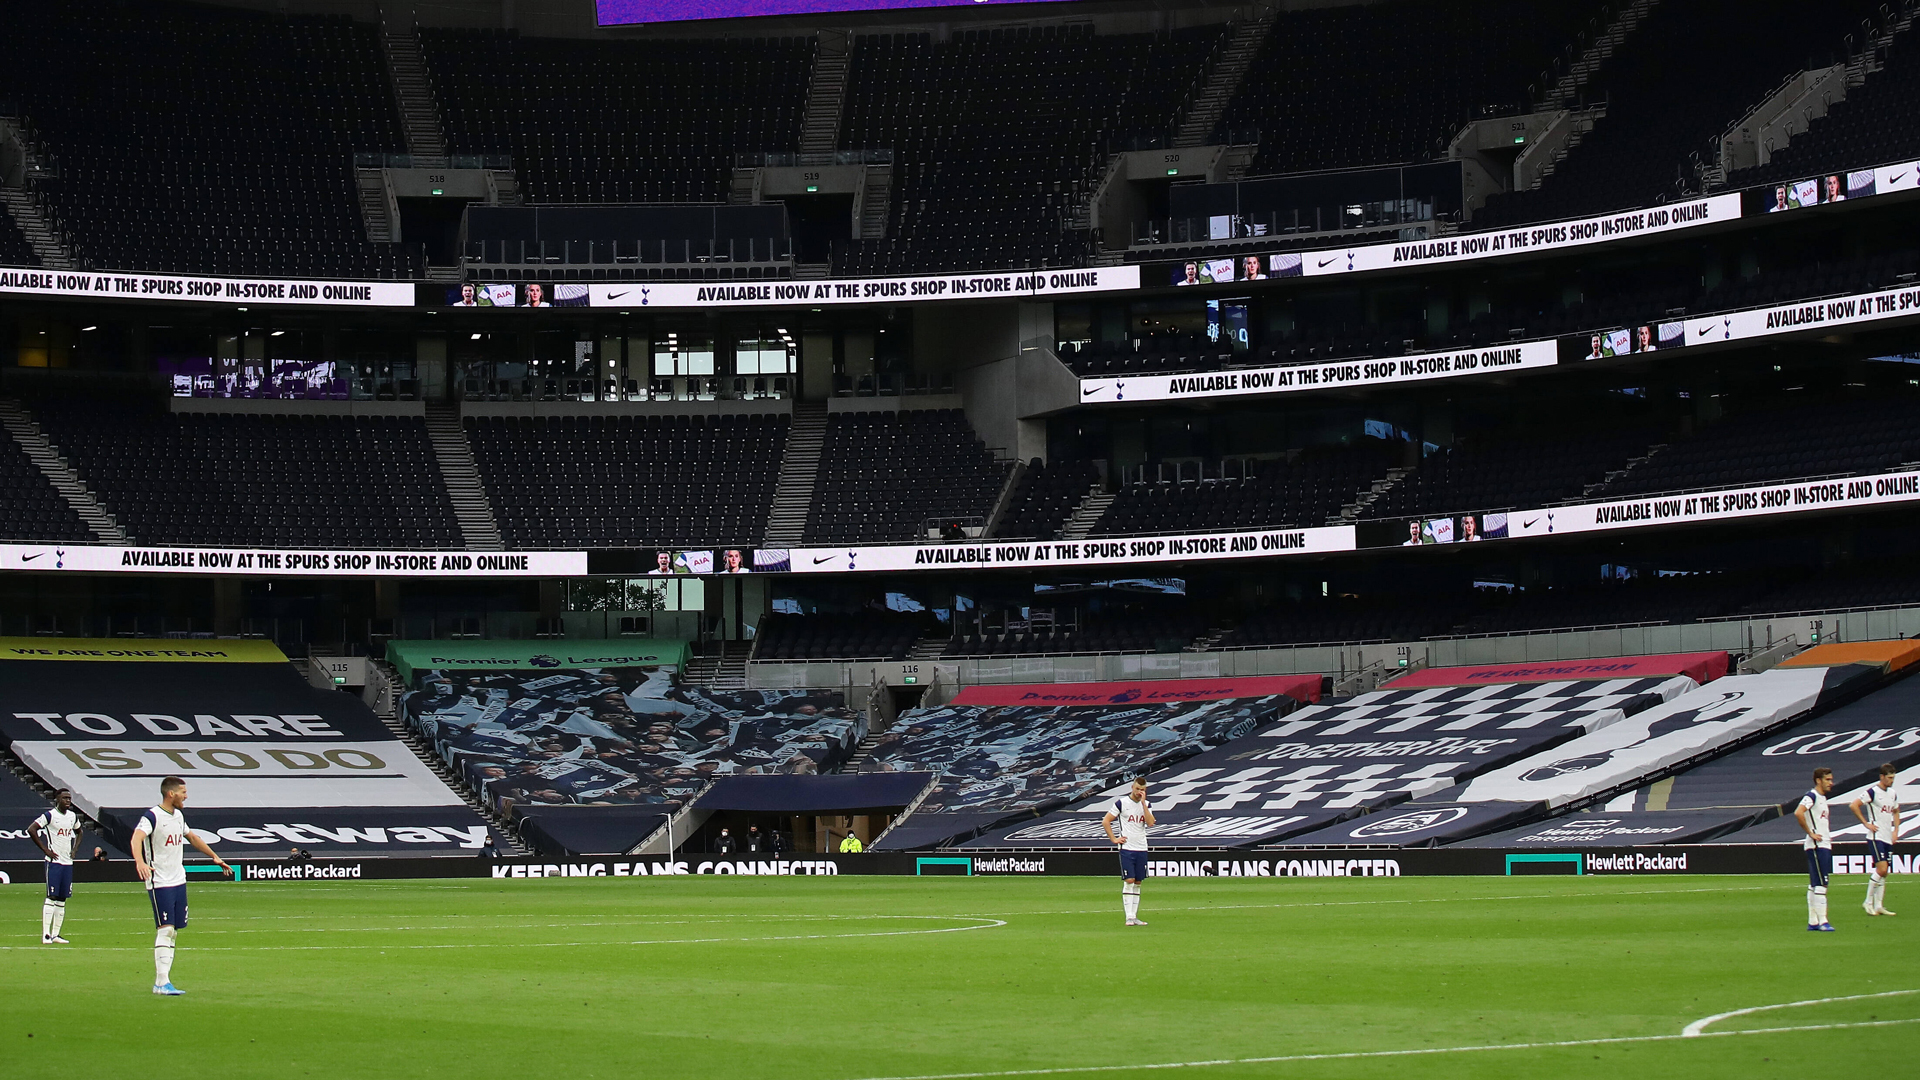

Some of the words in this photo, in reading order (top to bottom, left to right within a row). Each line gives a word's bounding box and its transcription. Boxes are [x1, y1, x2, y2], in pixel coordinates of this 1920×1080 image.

[1511, 122, 1525, 131] 521
[804, 172, 819, 180] 519
[1802, 187, 1815, 198] AIA
[1392, 240, 1458, 263] AVAILABLE
[1460, 236, 1490, 255] NOW
[1491, 234, 1506, 251] AT
[1507, 231, 1529, 249] THE
[1531, 226, 1567, 246] SPURS
[1569, 222, 1599, 241] SHOP
[1601, 213, 1645, 236] IN-STORE
[1646, 210, 1669, 229] AND
[1671, 202, 1709, 224] ONLINE
[1217, 265, 1231, 275] AIA
[56, 274, 91, 291] NOW
[93, 276, 112, 292] AT
[113, 277, 138, 293] THE
[141, 278, 184, 295] SPURS
[186, 280, 223, 297] SHOP
[225, 282, 285, 299] IN-STORE
[288, 283, 319, 300] AND
[322, 284, 372, 301] ONLINE
[496, 290, 511, 299] AIA
[696, 285, 771, 302] AVAILABLE
[774, 284, 811, 300] NOW
[813, 284, 832, 300] AT
[834, 283, 860, 299] THE
[863, 281, 907, 298] SPURS
[910, 280, 948, 296] SHOP
[951, 277, 1011, 294] IN-STORE
[1014, 273, 1047, 291] AND
[1049, 271, 1098, 289] ONLINE
[1766, 304, 1825, 330] AVAILABLE
[1827, 299, 1856, 321] NOW
[1858, 297, 1873, 316] AT
[1874, 294, 1897, 314] THE
[1616, 337, 1628, 347] AIA
[1168, 374, 1238, 394] AVAILABLE
[1241, 371, 1275, 389] NOW
[1278, 370, 1295, 387] AT
[1296, 368, 1319, 385] THE
[1321, 364, 1361, 383] SPURS
[1363, 361, 1397, 380] SHOP
[1399, 355, 1451, 376] IN-STORE
[1453, 353, 1478, 371] AND
[1480, 347, 1522, 368] ONLINE
[1595, 502, 1652, 524] AVAILABLE
[1653, 499, 1682, 519] NOW
[1684, 497, 1698, 516] AT
[1699, 495, 1720, 514] THE
[1722, 491, 1758, 512] SPURS
[1760, 488, 1791, 509] SHOP
[1793, 483, 1845, 505] IN-STORE
[1846, 480, 1873, 500] AND
[1875, 475, 1920, 497] ONLINE
[1438, 525, 1450, 535] AIA
[914, 546, 992, 565] AVAILABLE
[995, 545, 1031, 562] NOW
[1033, 545, 1052, 561] AT
[1053, 544, 1080, 560] THE
[1083, 542, 1127, 559] SPURS
[1129, 540, 1166, 557] SHOP
[1168, 537, 1227, 555] IN-STORE
[1229, 535, 1258, 553] AND
[1260, 532, 1306, 551] ONLINE
[121, 550, 195, 568] AVAILABLE
[198, 551, 234, 568] NOW
[236, 552, 254, 569] AT
[257, 553, 282, 569] THE
[284, 553, 330, 570] SPURS
[333, 553, 372, 570] SHOP
[374, 554, 437, 571] IN-STORE
[440, 554, 473, 571] AND
[476, 554, 529, 571] ONLINE
[694, 557, 709, 566] AIA
[158, 650, 229, 658] TEAM
[430, 656, 521, 666] Premier
[567, 654, 658, 664] League
[902, 665, 919, 673] 116
[1466, 670, 1498, 680] WE
[1497, 669, 1535, 677] ARE
[1536, 667, 1578, 676] ONE
[1577, 663, 1638, 673] TEAM
[1019, 692, 1106, 701] Premier
[1146, 688, 1235, 699] League
[12, 712, 127, 735] TO
[131, 713, 345, 736] DARE
[56, 747, 144, 770] IS
[141, 748, 261, 770] TO
[263, 748, 388, 771] DO
[1128, 814, 1145, 824] AIA
[1164, 815, 1310, 837] HILL
[973, 857, 1009, 872] Hewlett
[1008, 857, 1045, 872] Packard
[1147, 860, 1215, 877] EEPING
[1586, 853, 1635, 871] Hewlett
[1635, 852, 1688, 870] Packard
[246, 865, 303, 880] Hewlett
[304, 863, 361, 879] Packard
